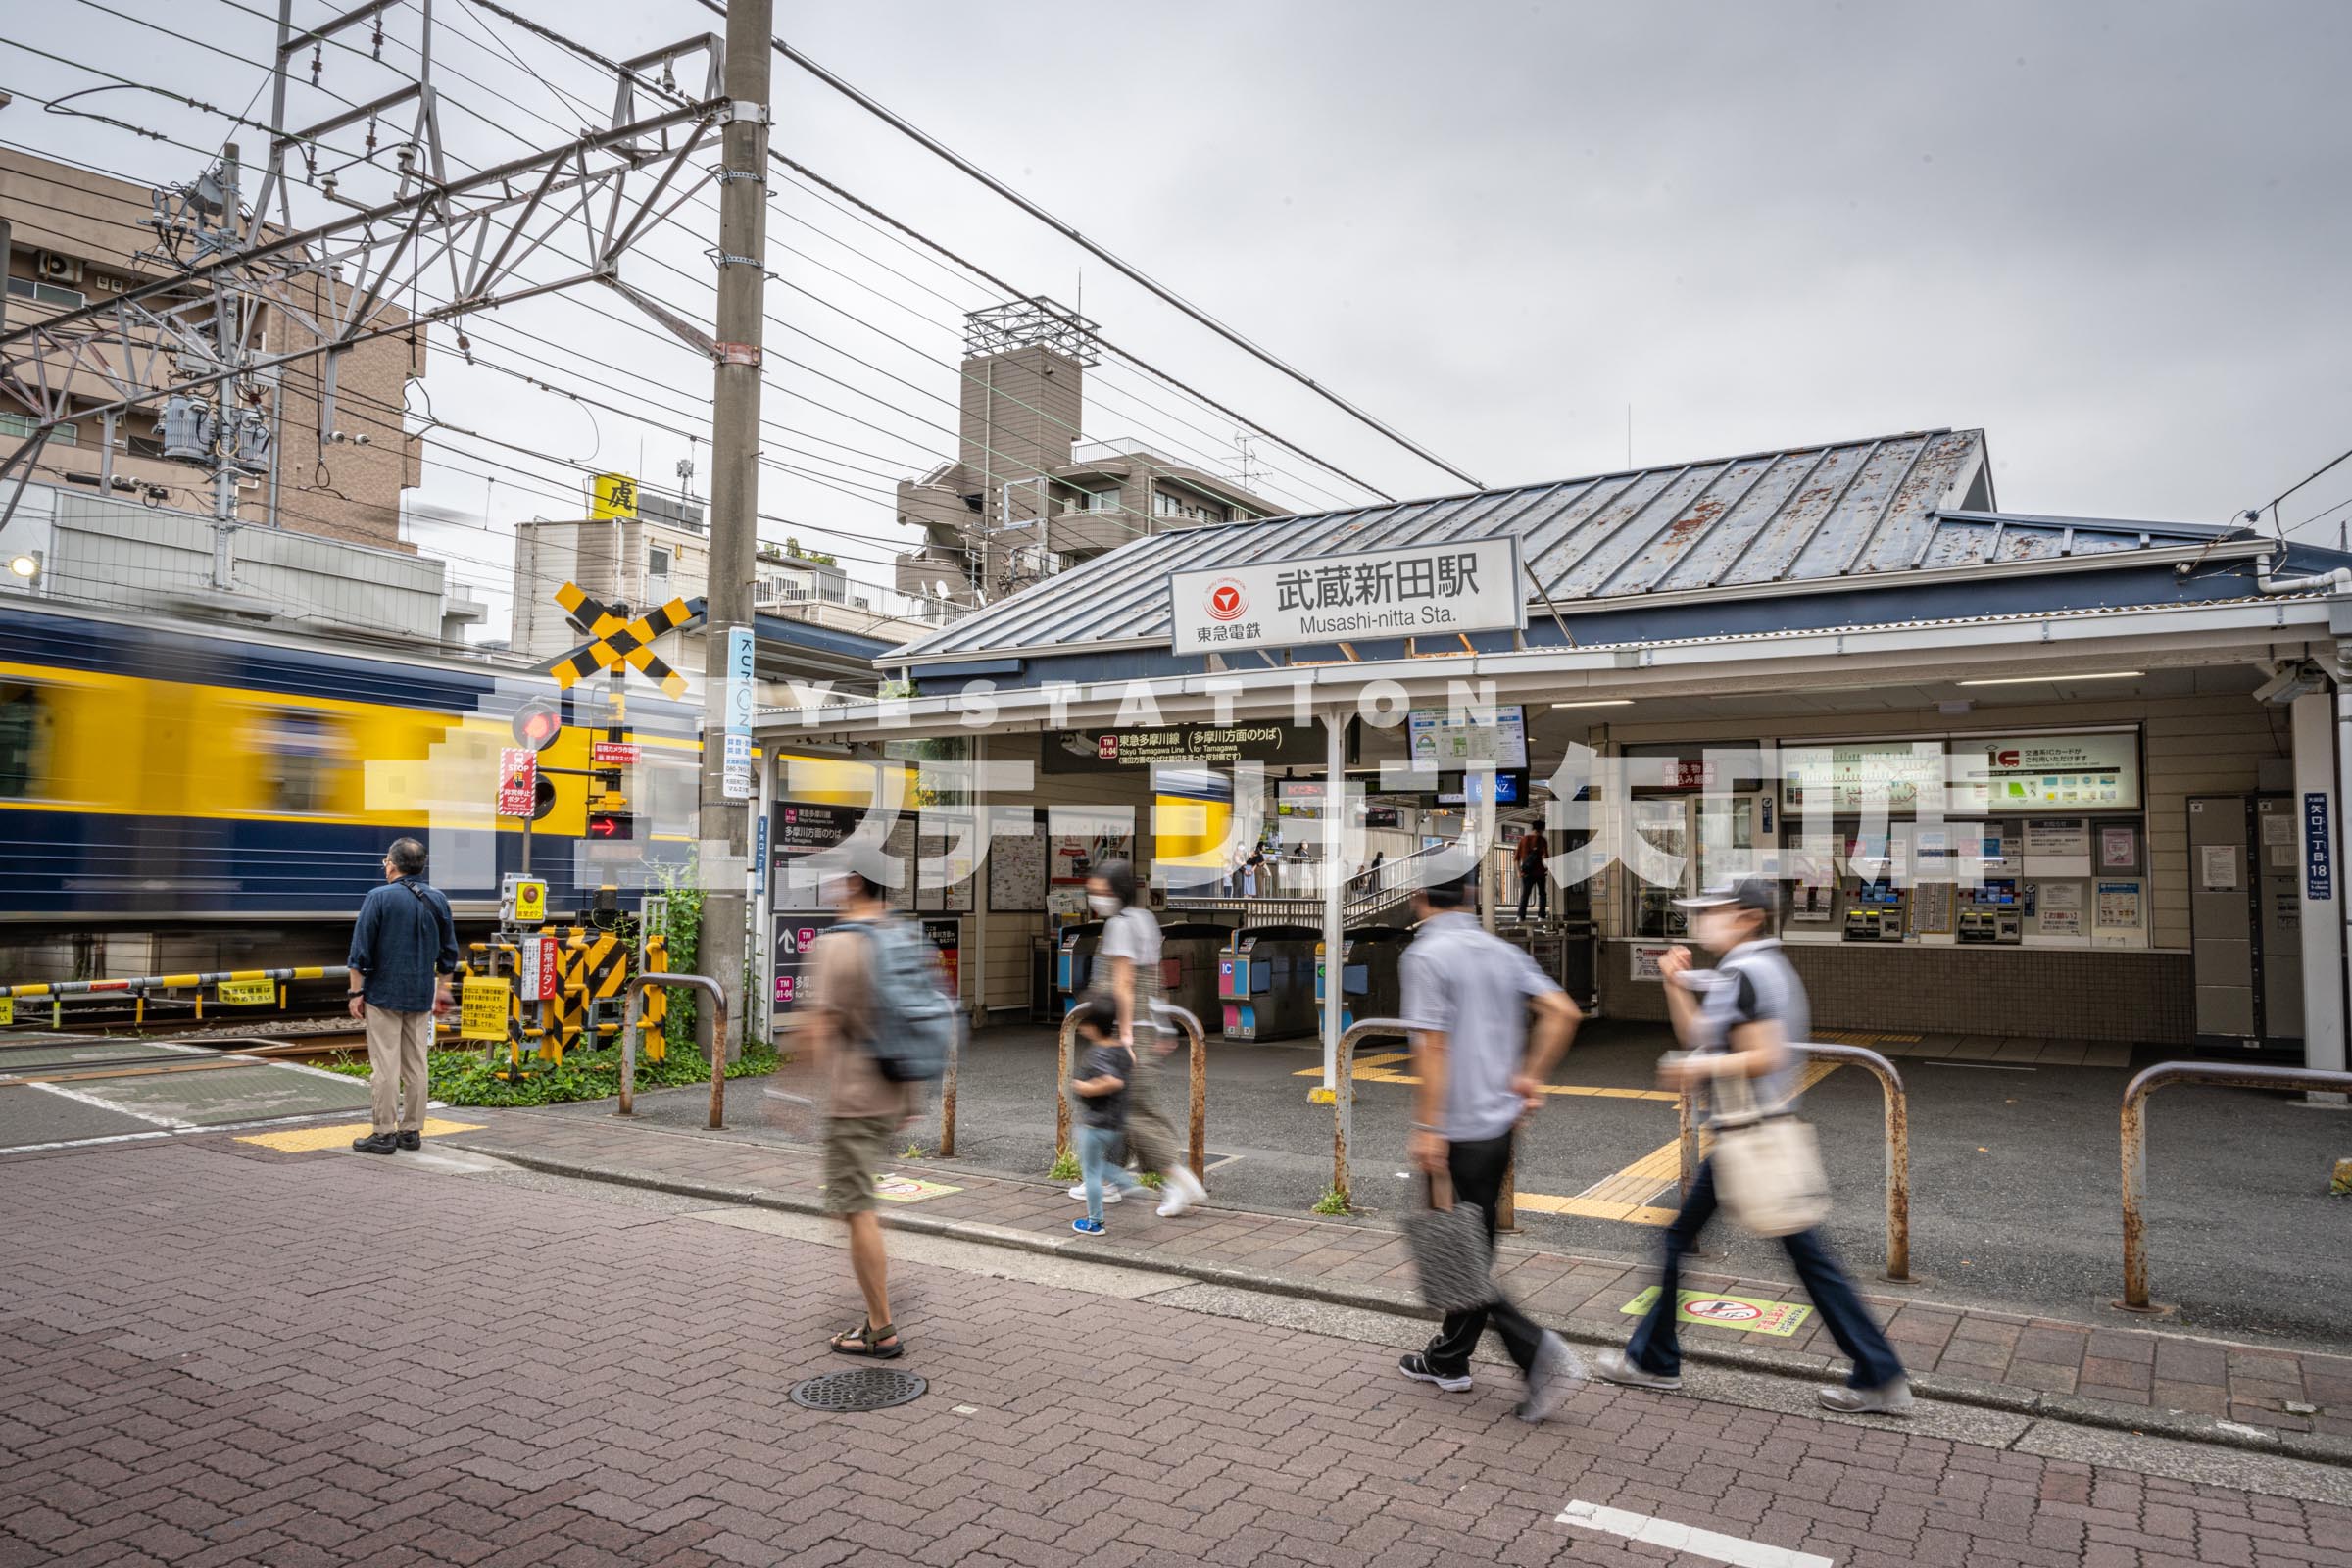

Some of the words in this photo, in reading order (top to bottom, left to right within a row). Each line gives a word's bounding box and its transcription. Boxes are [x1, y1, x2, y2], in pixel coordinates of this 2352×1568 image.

[1275, 552, 1479, 612] 武蔵新田駅
[1300, 607, 1415, 635] Musashi-nitta
[1421, 604, 1457, 625] Sta.
[1197, 621, 1262, 643] 東急電鉄
[737, 639, 752, 727] KUMON
[1119, 732, 1180, 747] 東急多摩川線
[1138, 746, 1170, 756] Tamagawa
[1204, 744, 1238, 754] Tamagawa
[785, 825, 842, 840] 多摩川方面のりば
[2311, 805, 2325, 862] 矢口一丁目
[2311, 864, 2328, 878] 18
[543, 941, 555, 996] 非常ボタン
[1221, 963, 1232, 975] IC
